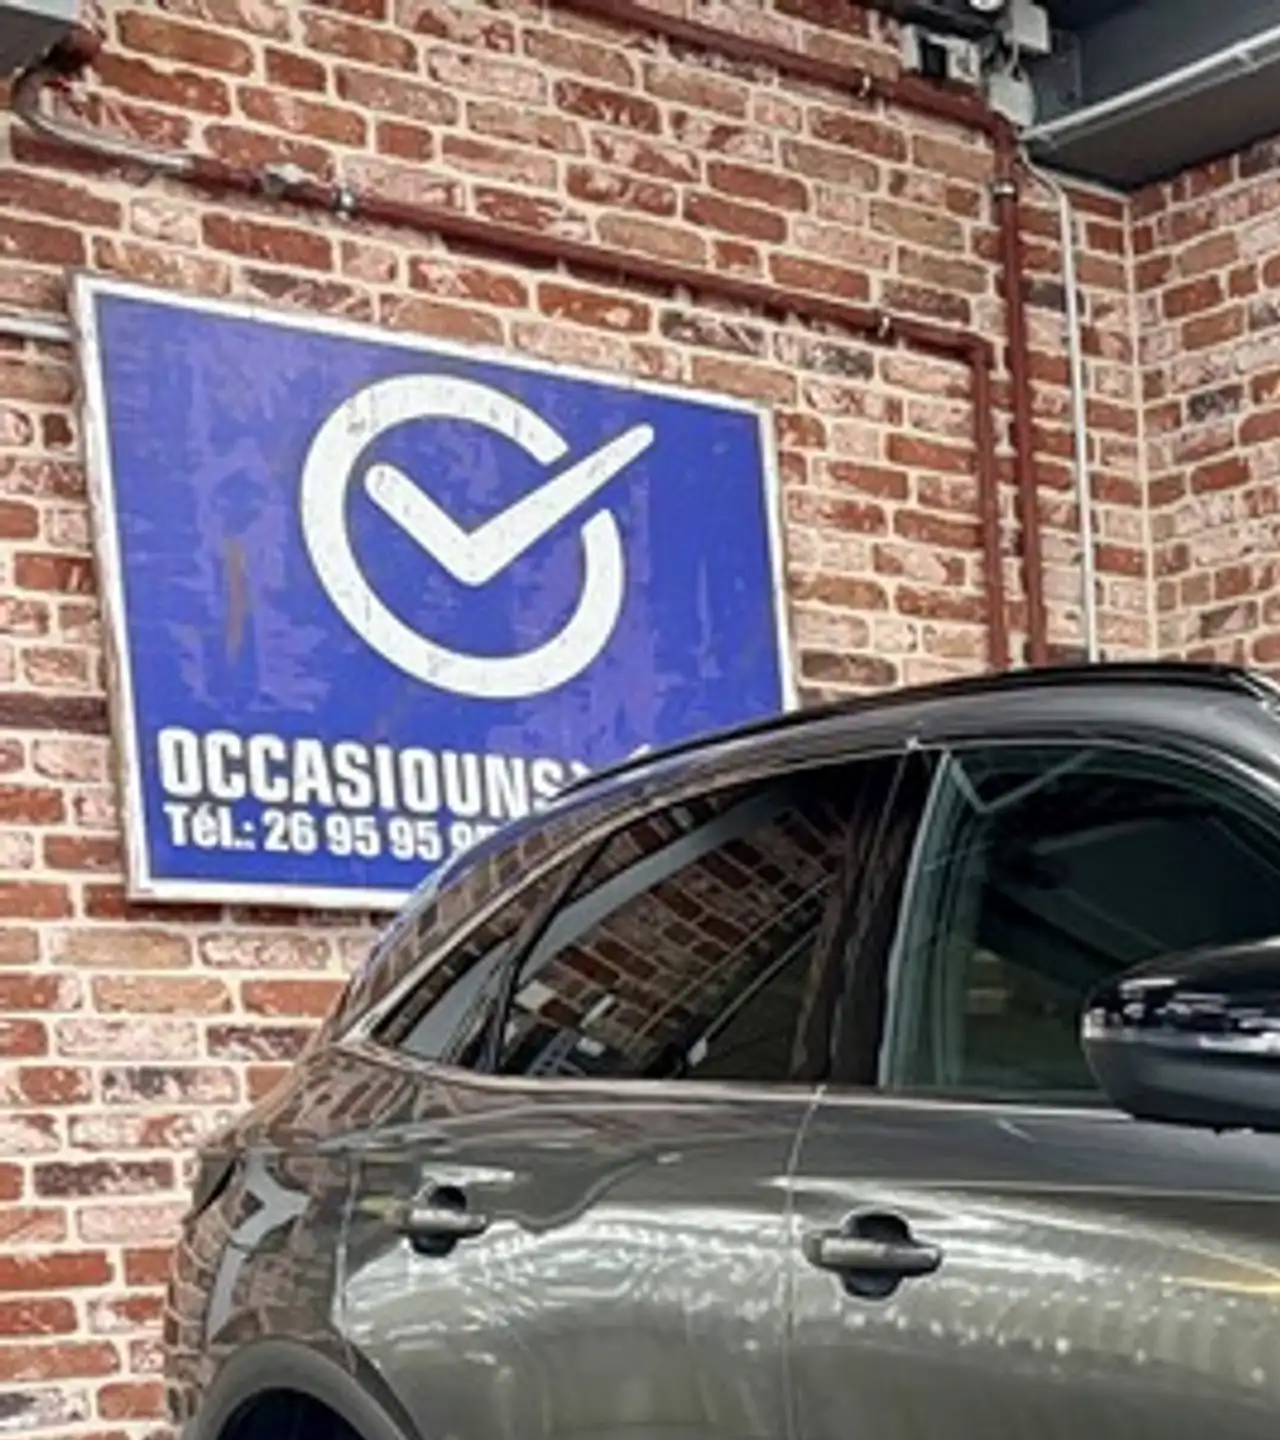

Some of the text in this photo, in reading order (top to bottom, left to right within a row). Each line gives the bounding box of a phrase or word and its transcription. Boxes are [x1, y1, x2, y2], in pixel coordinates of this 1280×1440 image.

[263, 807, 318, 852] 26
[325, 817, 379, 857] 95
[389, 820, 442, 860] 95
